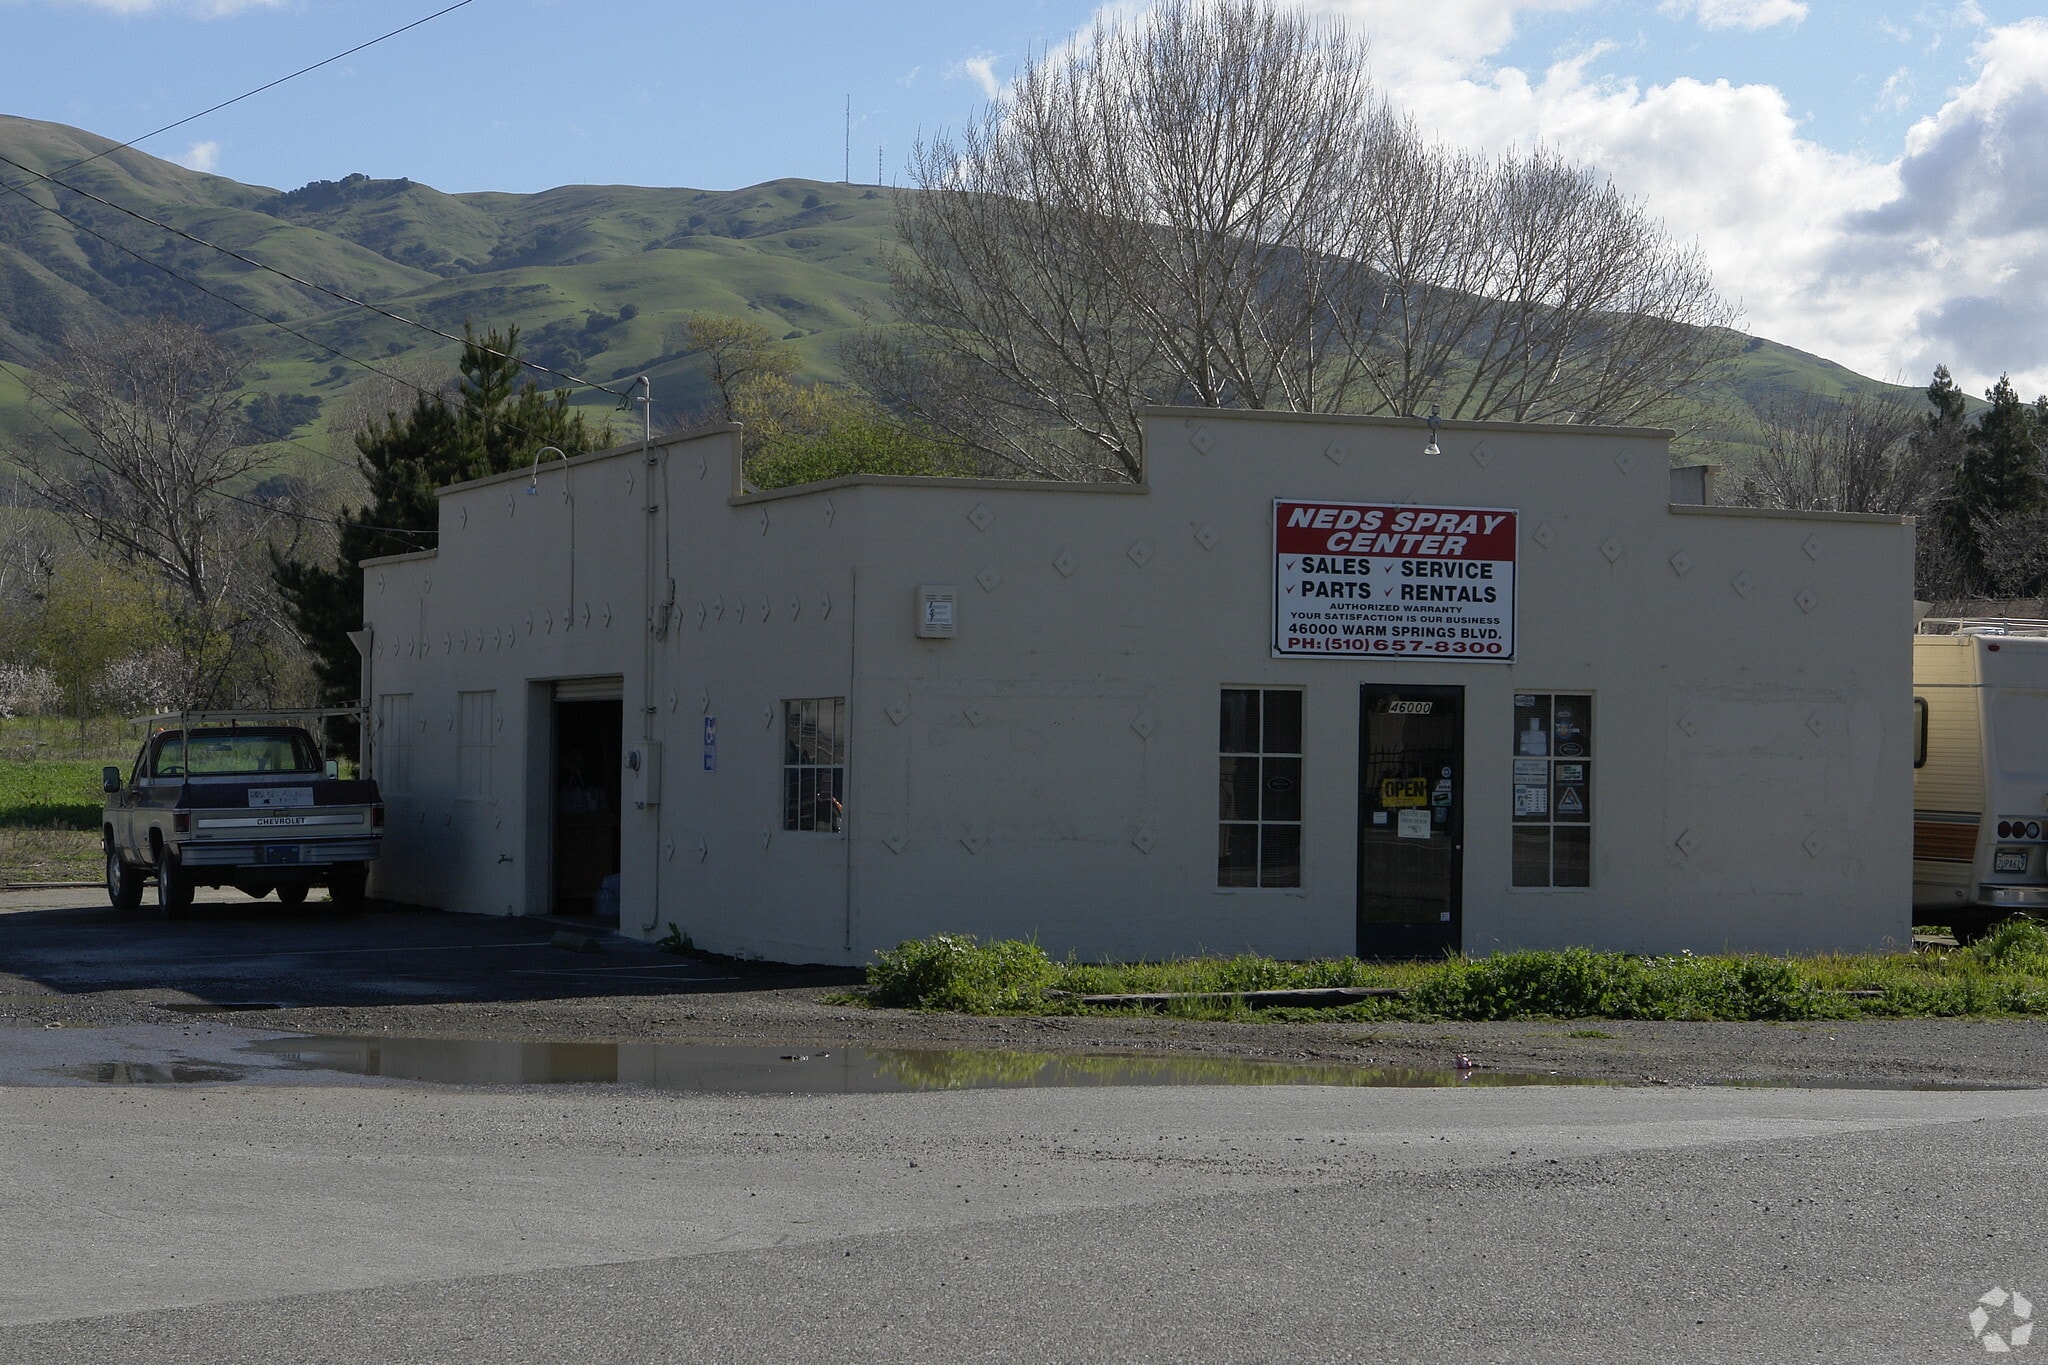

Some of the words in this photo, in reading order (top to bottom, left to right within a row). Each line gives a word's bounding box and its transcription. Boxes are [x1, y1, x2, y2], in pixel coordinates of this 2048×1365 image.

[1286, 507, 1385, 532] NEDS
[1391, 511, 1507, 535] SPRAY
[1326, 531, 1468, 556] CENTER
[1301, 556, 1371, 576] SALES
[1401, 560, 1493, 579] SERVICE
[1301, 580, 1371, 600] PARTS
[1401, 584, 1497, 603] RENTALS
[1329, 603, 1400, 612] AUTHORIZED
[1403, 605, 1463, 614] WARRANTY
[1290, 611, 1321, 620] YOUR
[1324, 612, 1403, 622] SATISFACTION
[1406, 615, 1417, 623] IS
[1420, 615, 1443, 624] OUR
[1445, 616, 1500, 625] BUSINESS
[1288, 623, 1338, 635] 46000
[1342, 625, 1387, 636] WARM
[1391, 626, 1456, 638] SPRINGS
[1460, 628, 1502, 640] BLVD.
[1373, 639, 1503, 654] 657-8300
[1390, 702, 1432, 714] 46000
[1385, 781, 1425, 798] OPEN
[256, 817, 305, 826] CHEVROLET
